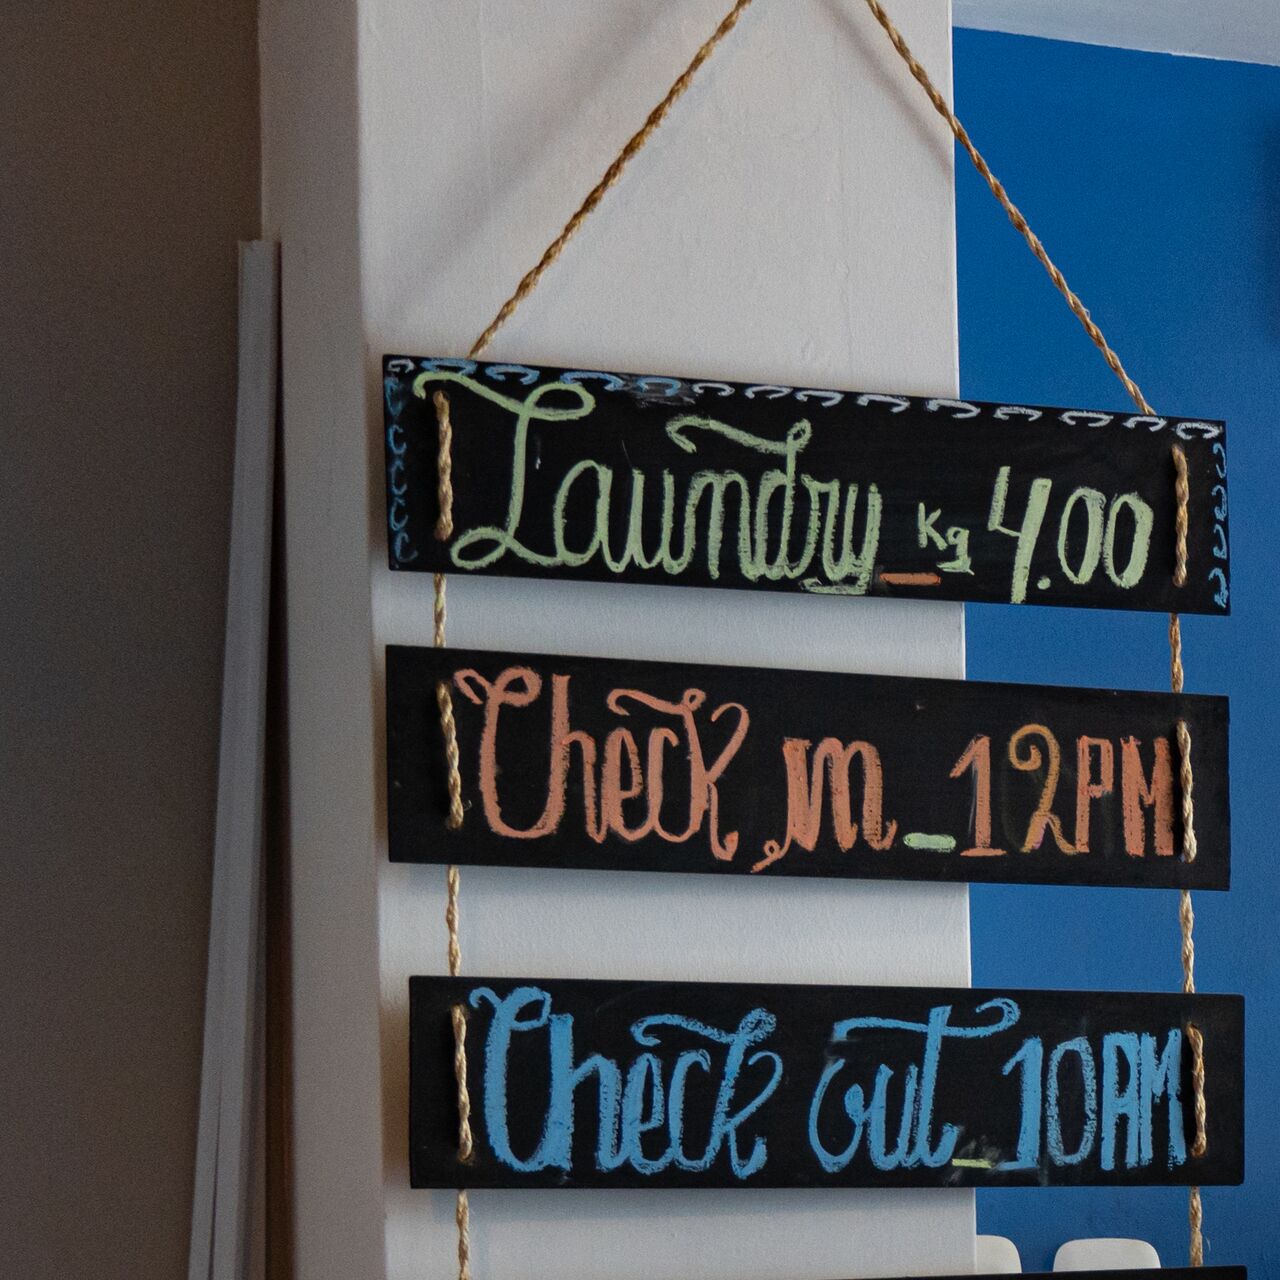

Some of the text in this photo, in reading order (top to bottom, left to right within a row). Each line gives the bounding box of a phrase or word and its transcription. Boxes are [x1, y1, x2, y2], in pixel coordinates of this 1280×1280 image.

[414, 370, 882, 596] Laundry
[988, 465, 1154, 604] 4.00
[454, 666, 750, 863] Check
[949, 723, 1174, 858] 12PM
[469, 985, 783, 1180] Check
[808, 998, 1021, 1173] out
[996, 1028, 1187, 1172] 10AM
